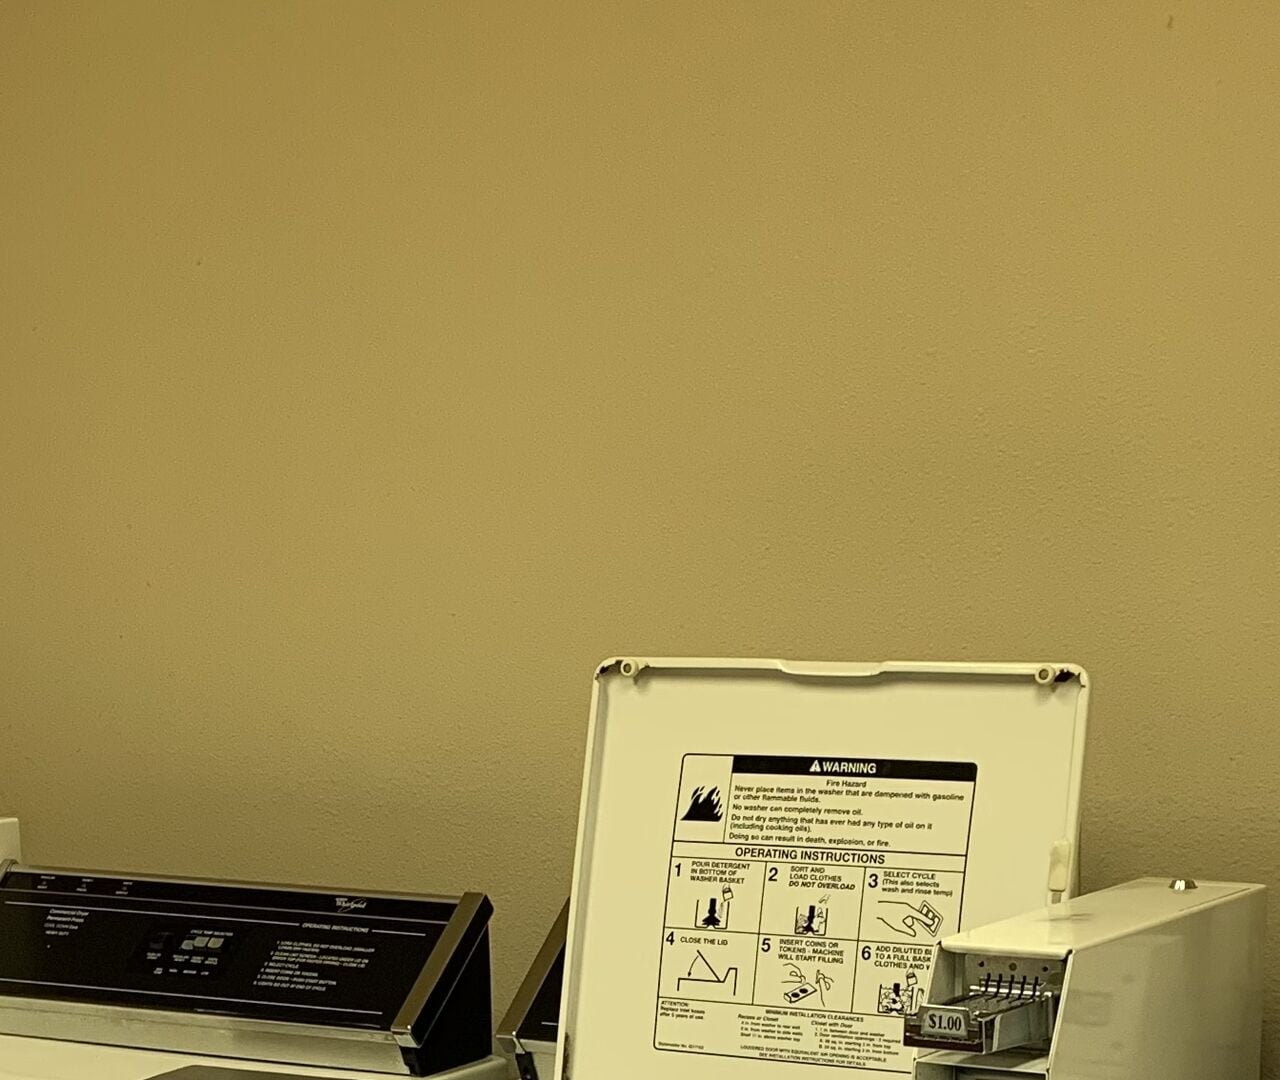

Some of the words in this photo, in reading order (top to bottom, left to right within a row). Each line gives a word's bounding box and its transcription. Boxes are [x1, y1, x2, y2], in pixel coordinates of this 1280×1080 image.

[822, 760, 876, 774] WARNING
[756, 787, 774, 795] place
[874, 791, 913, 800] dampened
[932, 794, 964, 802] gasoline
[784, 807, 822, 815] completely
[768, 817, 799, 825] anything
[730, 824, 764, 832] (including
[765, 825, 794, 833] cooking
[729, 834, 749, 842] Doing
[805, 837, 826, 845] death,
[828, 838, 865, 847] explosion,
[735, 849, 798, 860] OPERATING
[800, 852, 885, 864] INSTRUCTIONS
[675, 864, 681, 876] 1
[768, 868, 778, 881] 2
[869, 874, 879, 888] 3
[666, 932, 674, 944] 4
[761, 939, 771, 952] 5
[862, 946, 871, 960] 6
[928, 1014, 962, 1031] $1.00
